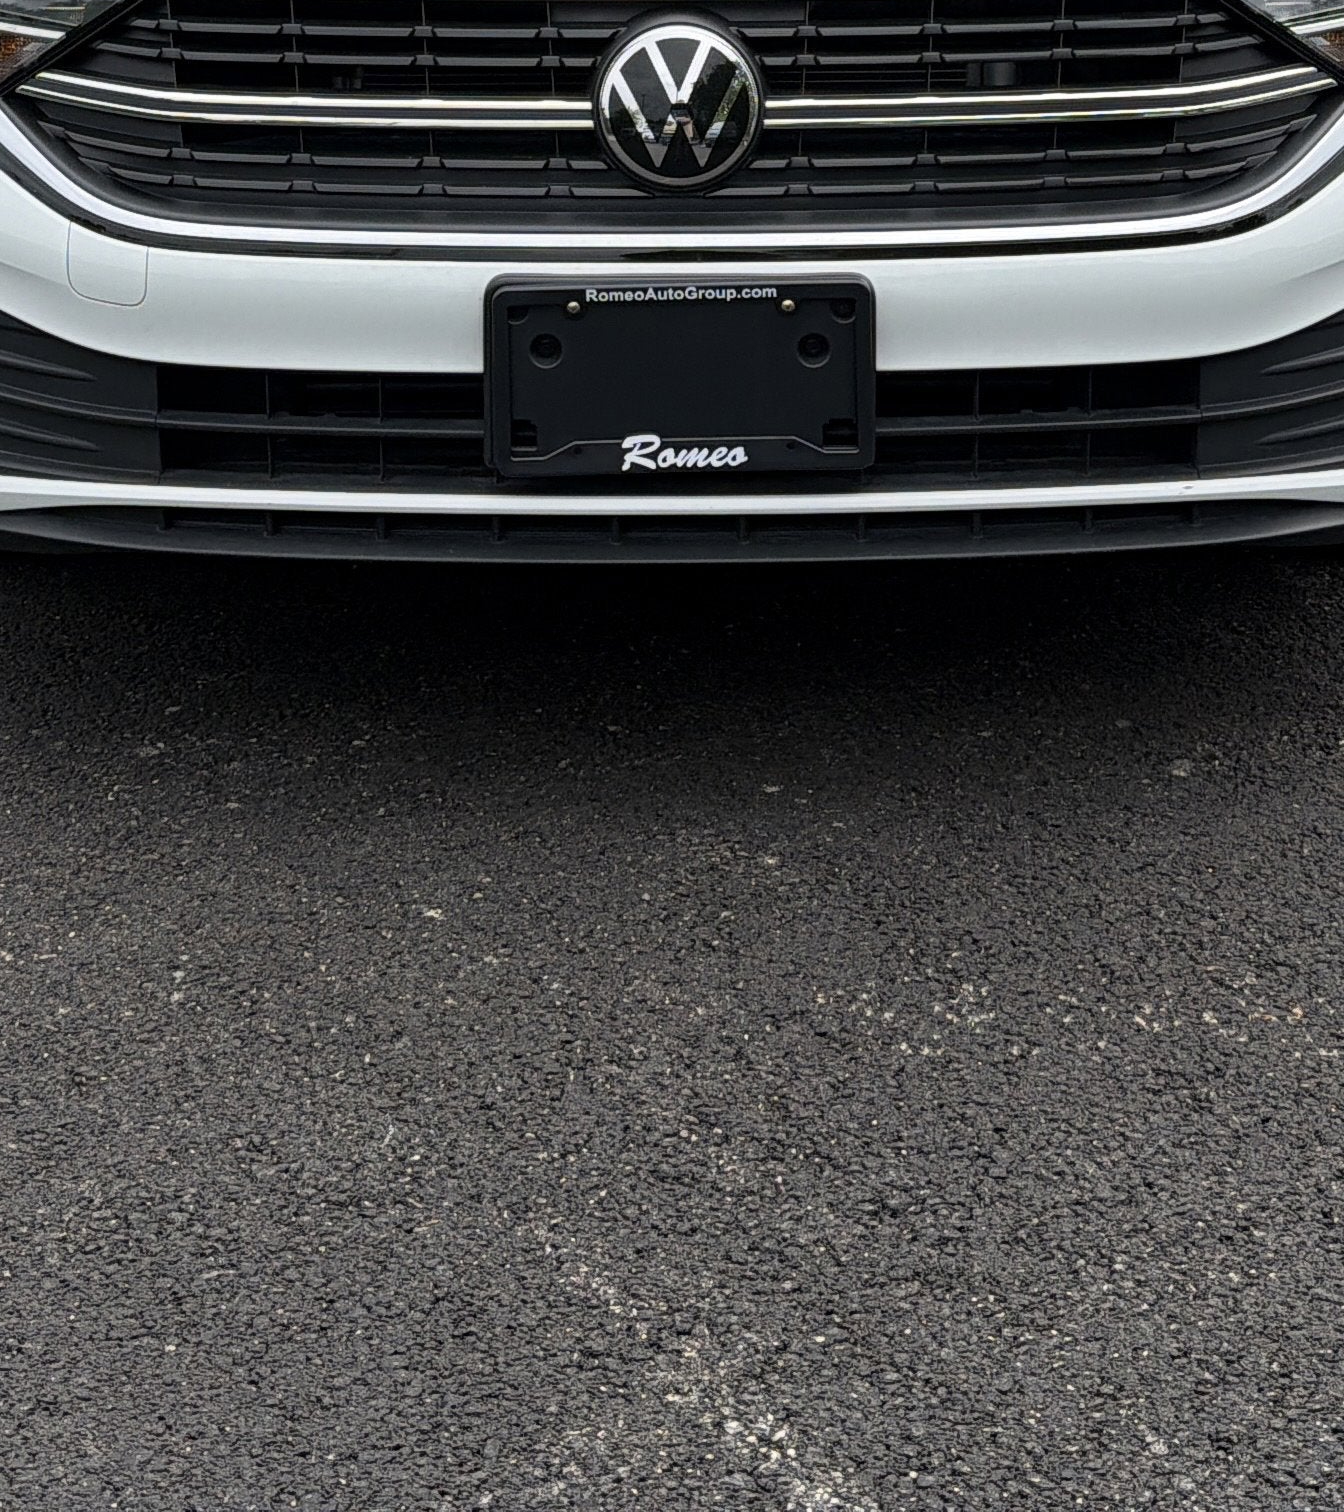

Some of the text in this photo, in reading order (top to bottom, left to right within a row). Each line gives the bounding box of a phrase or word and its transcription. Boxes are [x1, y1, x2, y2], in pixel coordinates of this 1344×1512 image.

[603, 28, 759, 180] VW
[585, 286, 777, 302] RomeoAutoGroup.com
[621, 434, 749, 471] Romeo
